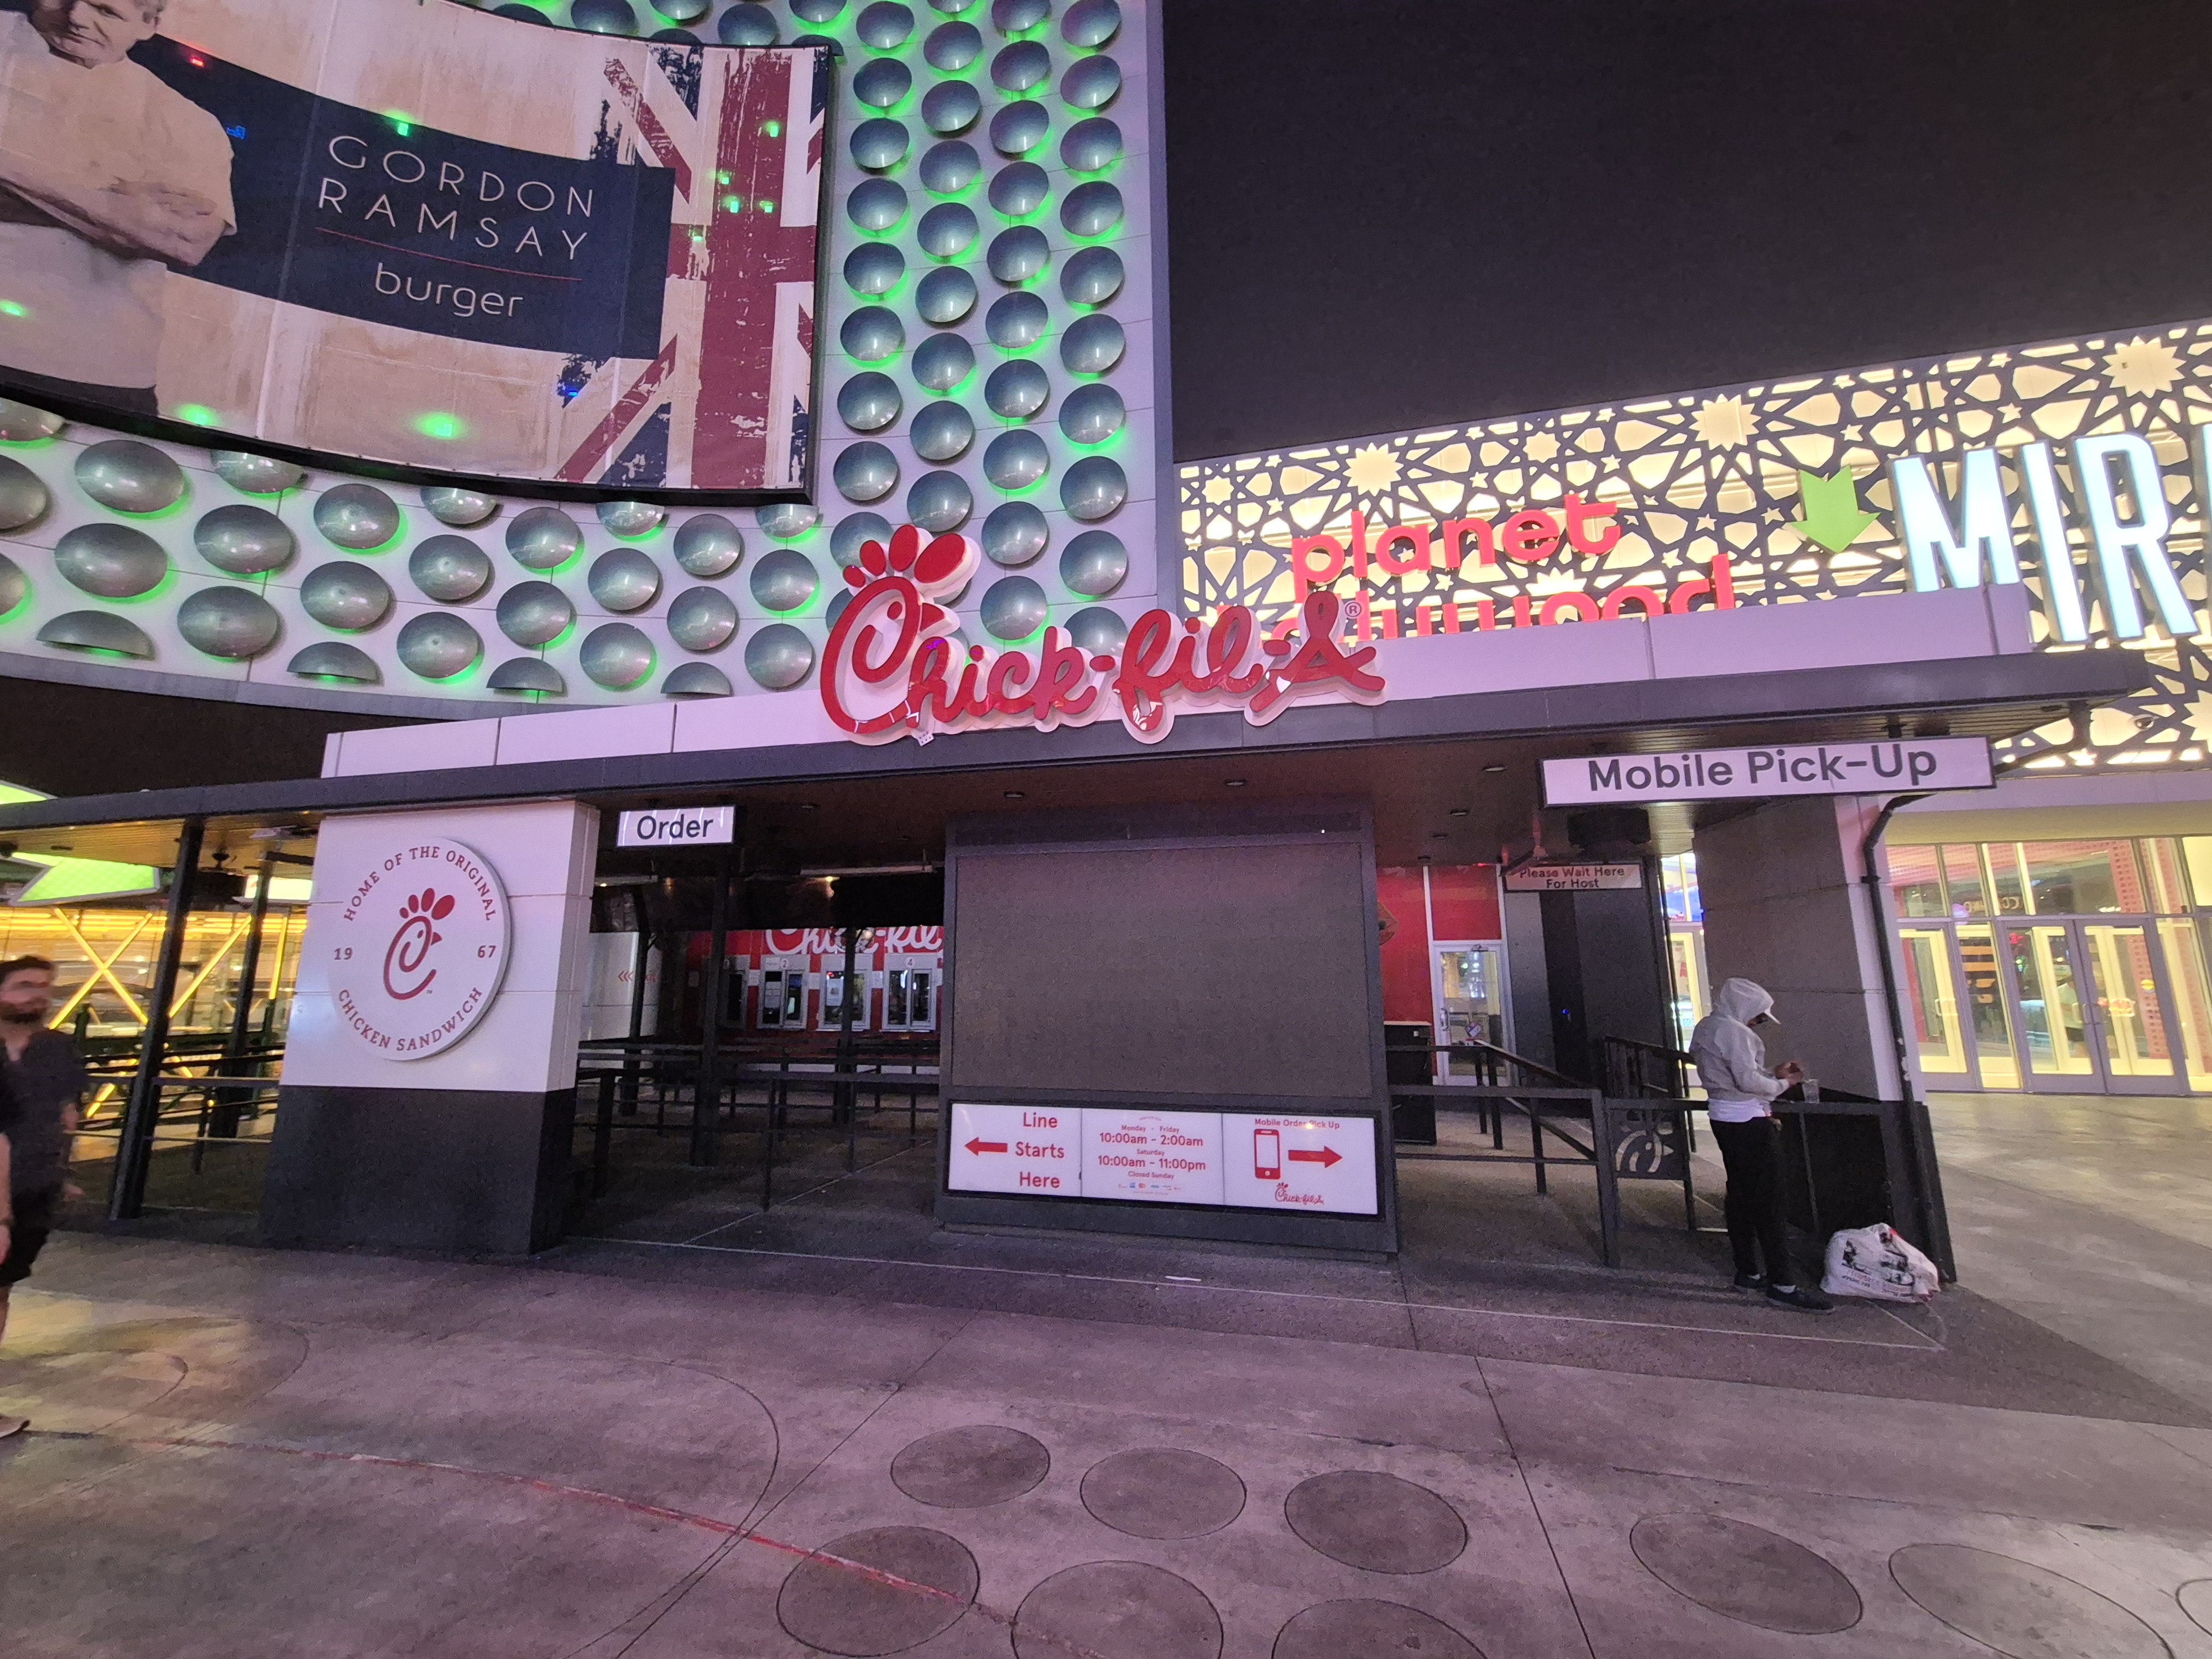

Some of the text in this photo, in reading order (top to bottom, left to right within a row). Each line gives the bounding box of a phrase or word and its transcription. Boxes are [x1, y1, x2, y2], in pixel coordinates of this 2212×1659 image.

[329, 135, 593, 218] GORDON
[318, 178, 588, 260] RAMSAY
[375, 263, 524, 317] burger
[1893, 421, 2212, 643] MIR
[1292, 493, 1621, 604] planet
[820, 574, 1386, 735] Chick-fil-A
[1588, 744, 1937, 791] Mobile Pick-Up
[637, 815, 714, 839] Order
[1519, 866, 1625, 879] Please Wait Here
[343, 846, 497, 921] HOME OF THE ORIGINAL
[1546, 878, 1599, 889] For Host
[334, 947, 353, 961] 19
[477, 945, 497, 958] 67
[338, 987, 483, 1051] CHICKEN SANDWICH
[1023, 1112, 1058, 1128] Line
[1328, 1121, 1340, 1130] Up
[1099, 1132, 1147, 1144] 10:00am
[1160, 1135, 1203, 1146] 2:00am
[1015, 1141, 1065, 1159] Starts
[1098, 1155, 1146, 1167] 10:00am
[1159, 1158, 1206, 1172] 11:00pm
[1019, 1171, 1061, 1188] Here
